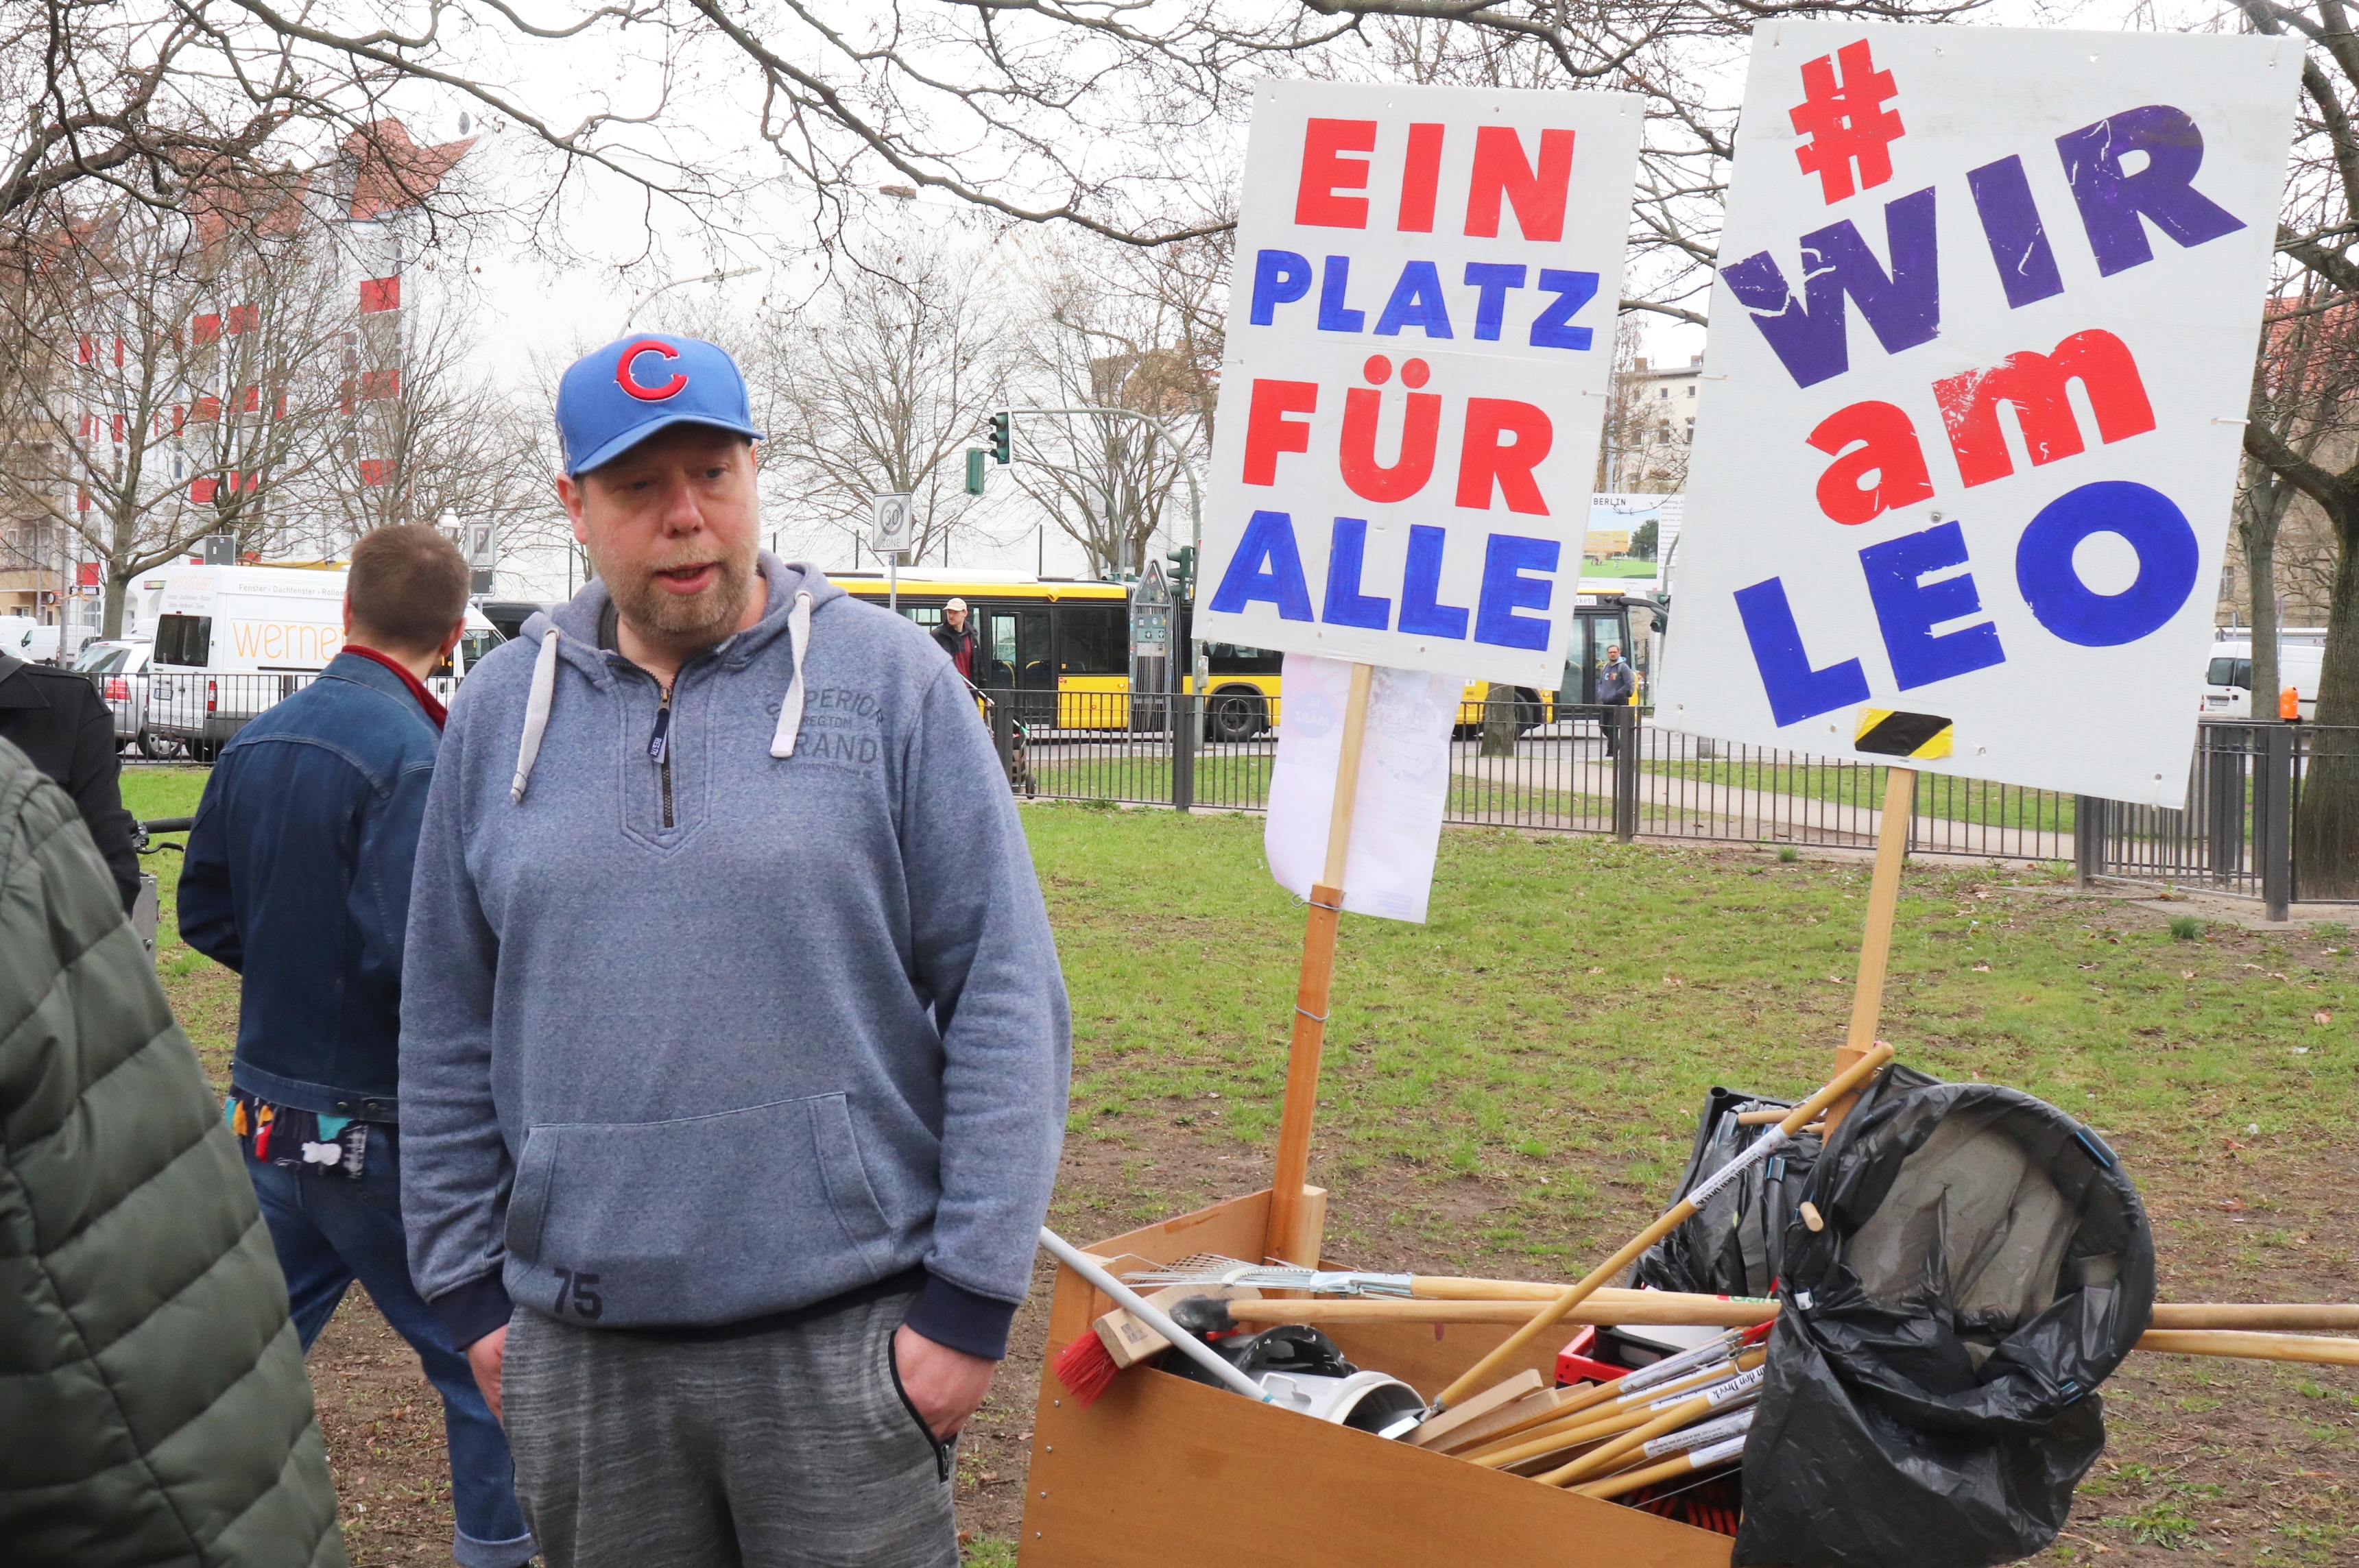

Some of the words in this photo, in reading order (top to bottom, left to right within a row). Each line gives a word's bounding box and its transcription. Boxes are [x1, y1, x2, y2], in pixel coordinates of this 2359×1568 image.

[1790, 39, 1906, 205] #
[1295, 118, 1575, 242] EIN
[1719, 108, 2245, 388] WIR
[1251, 250, 1600, 351] PLATZ
[613, 340, 688, 402] C
[1243, 355, 1553, 516] FÜR
[1806, 329, 2157, 526] am
[882, 538, 901, 548] ZONE
[885, 509, 899, 526] 30
[239, 583, 267, 592] Fenster
[274, 586, 315, 594] Dachfenster
[322, 588, 344, 596] Rollos
[1210, 511, 1561, 651] ALLE
[1734, 481, 2199, 728] LEO
[765, 688, 883, 727] SPERIOR
[771, 732, 878, 764] RAND
[554, 1268, 602, 1319] 75
[1739, 1372, 1755, 1384] den
